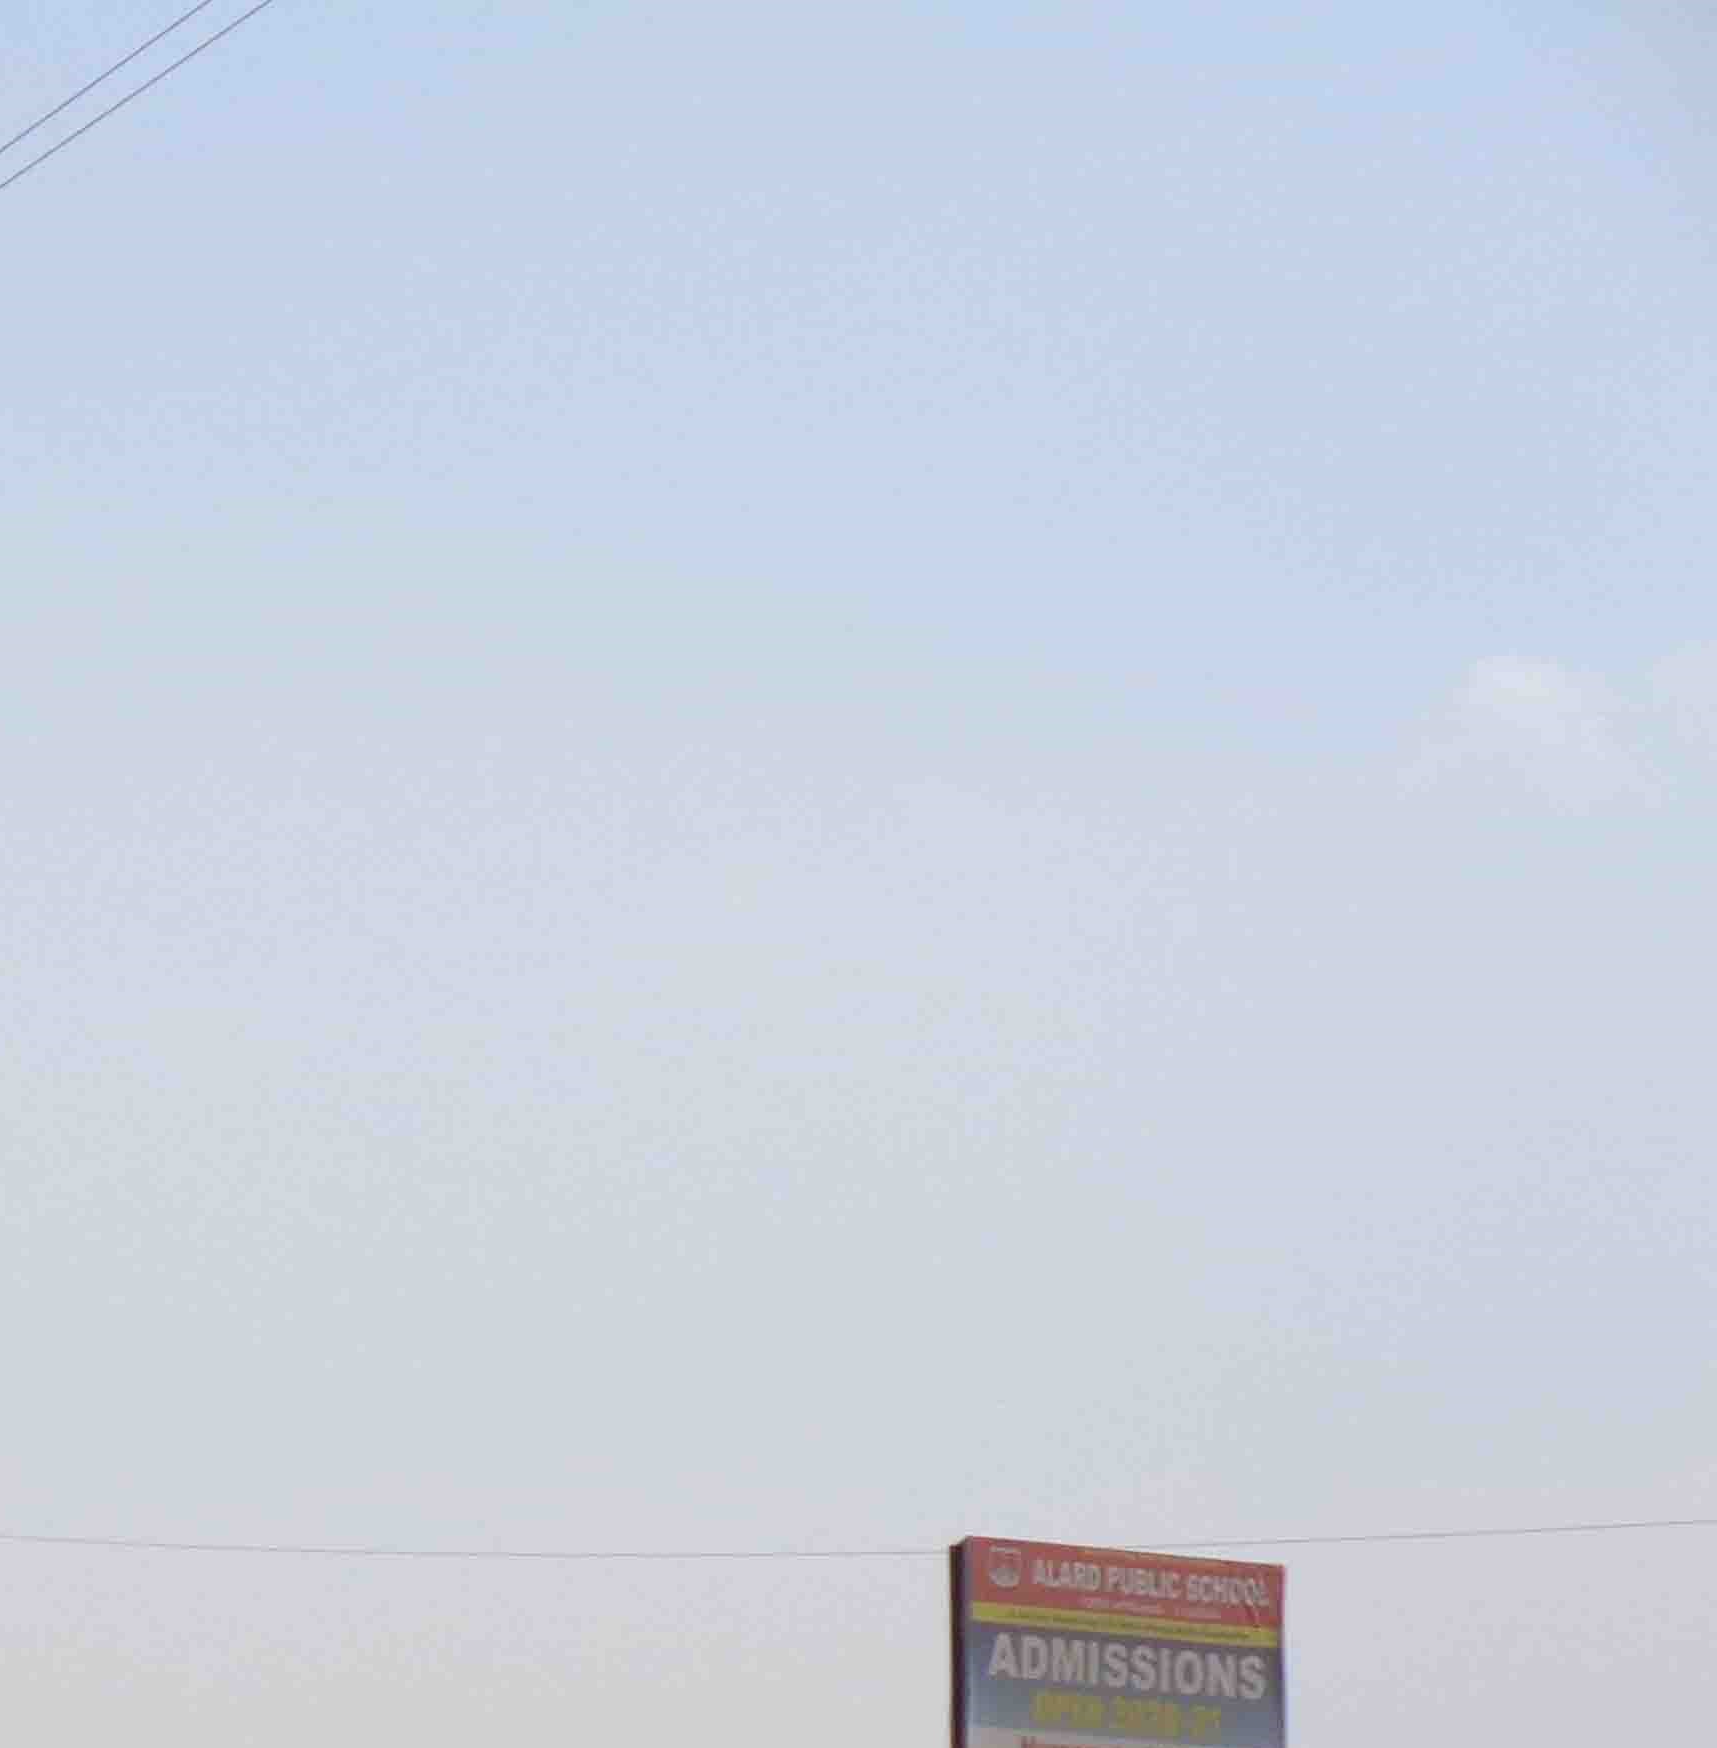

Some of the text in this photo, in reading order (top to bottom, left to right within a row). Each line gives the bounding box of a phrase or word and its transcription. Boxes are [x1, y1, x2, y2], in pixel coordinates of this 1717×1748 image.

[1032, 1561, 1269, 1607] ALARD PUBLIC SCHOOL
[988, 1632, 1266, 1699] ADMISSIONS
